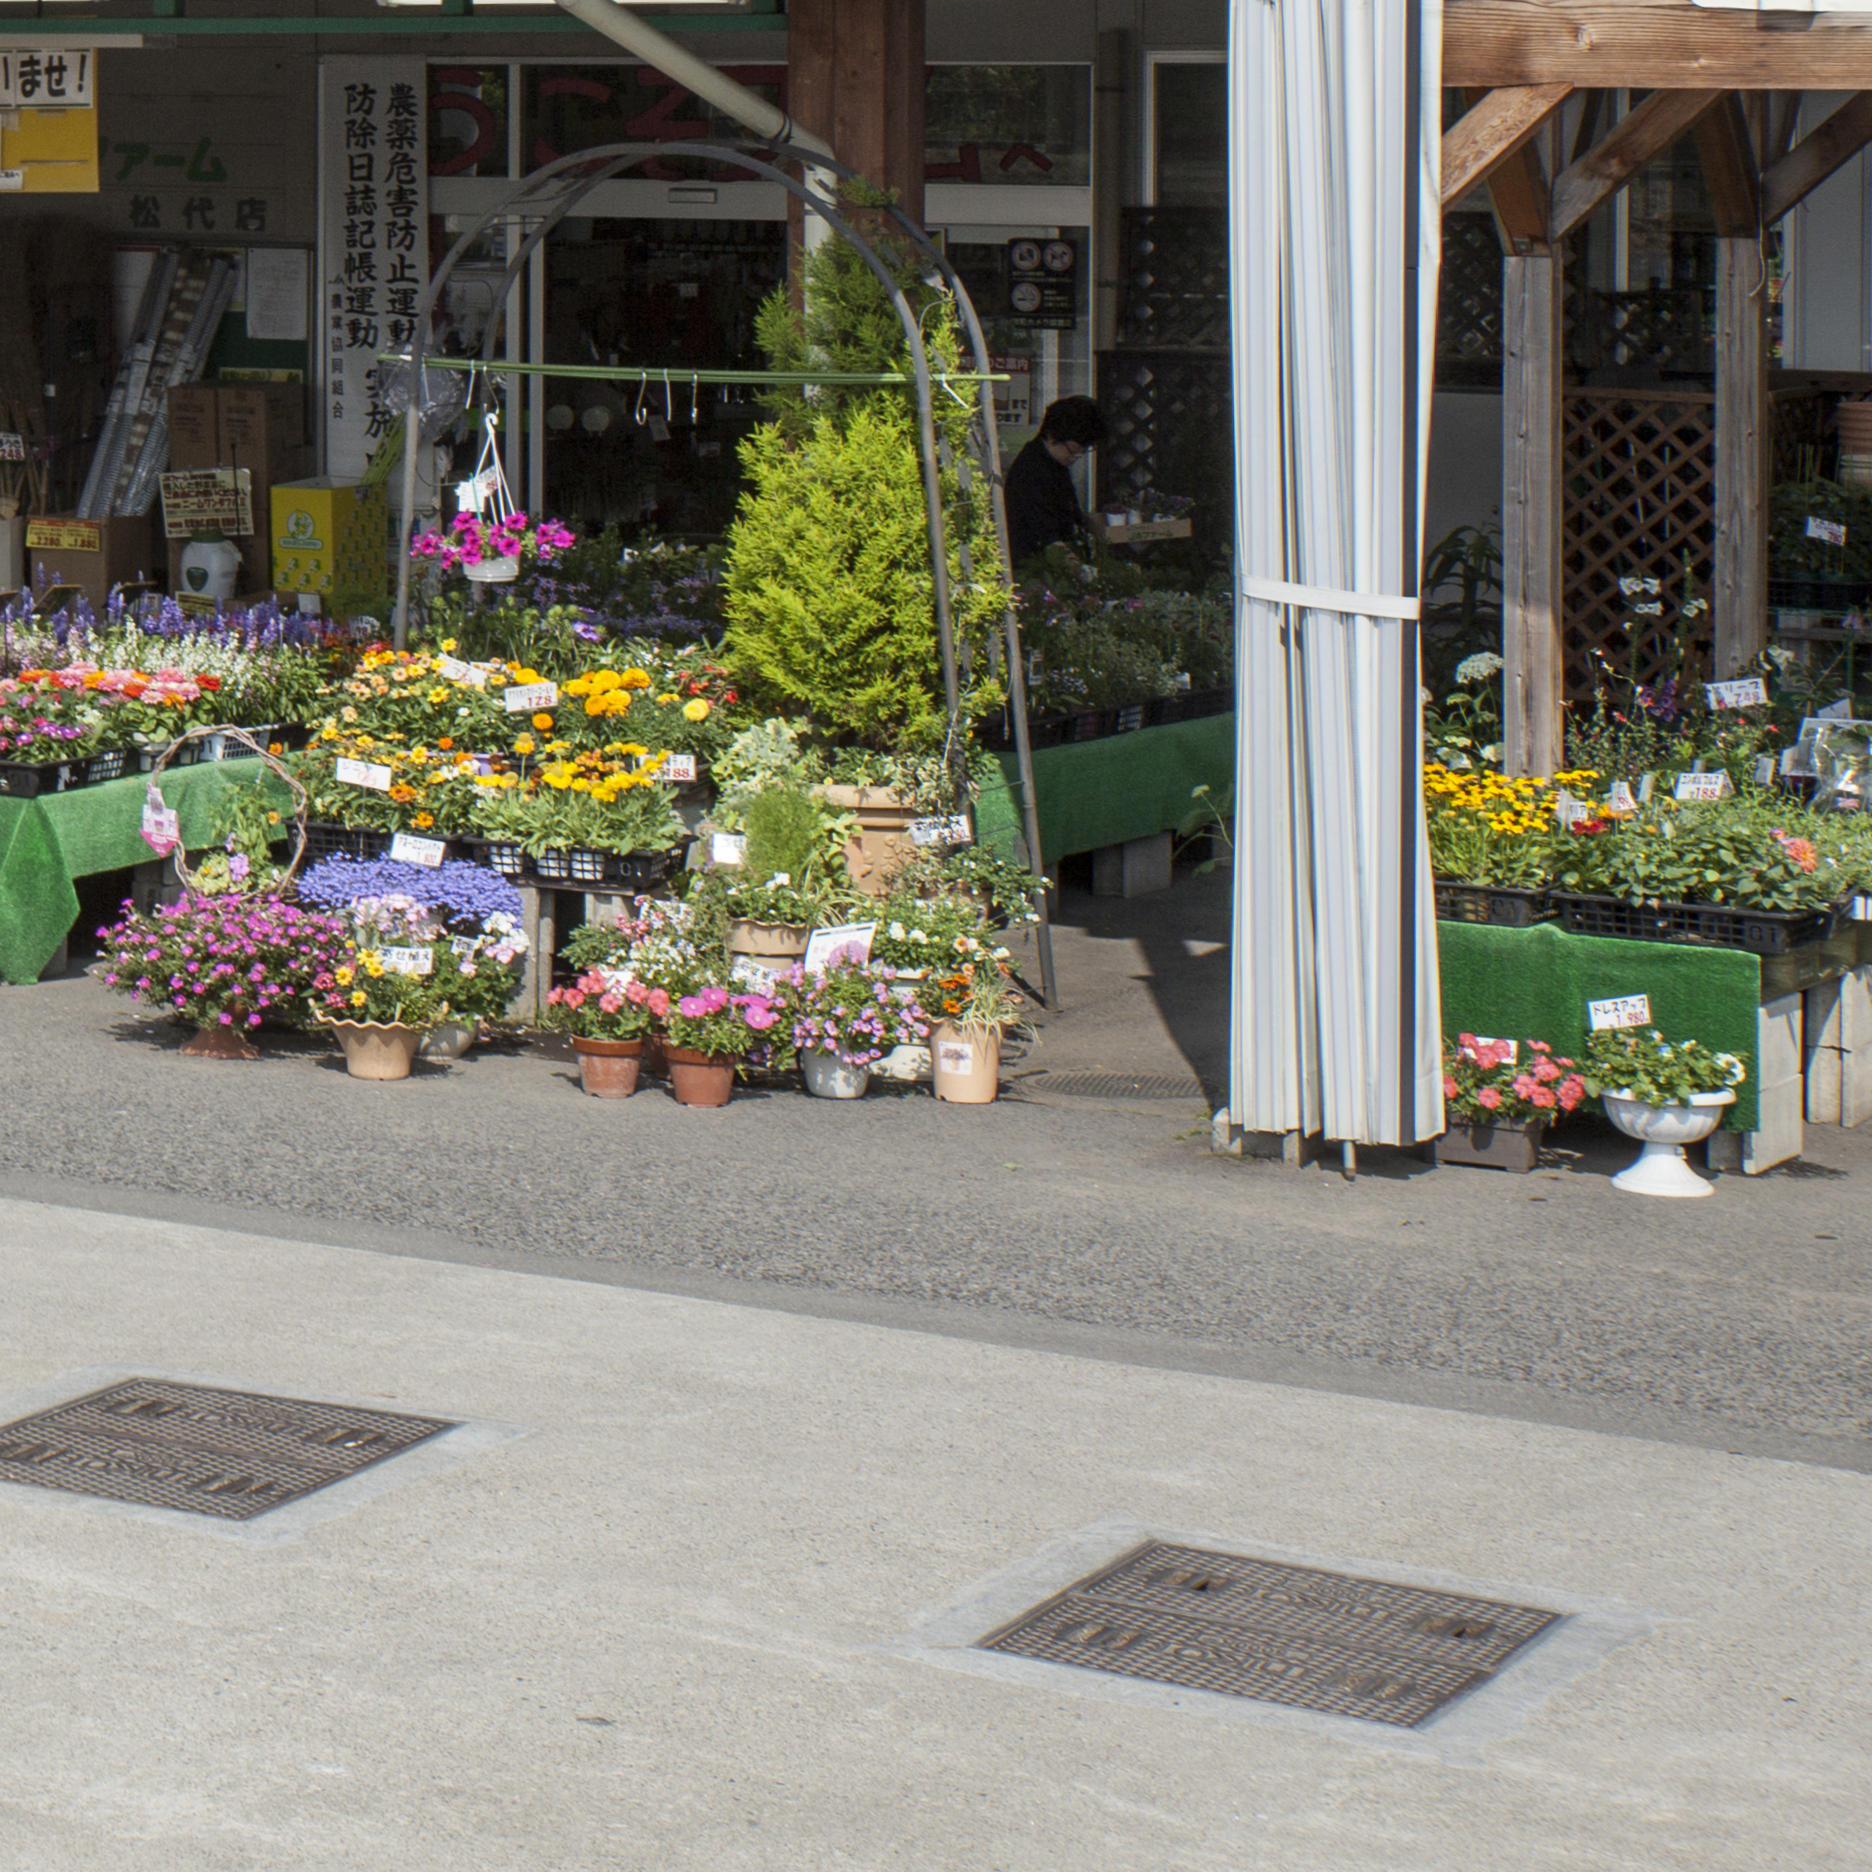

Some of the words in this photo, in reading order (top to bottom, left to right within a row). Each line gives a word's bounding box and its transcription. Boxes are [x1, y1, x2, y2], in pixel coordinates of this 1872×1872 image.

[129, 194, 267, 231] 松代店
[343, 81, 380, 350] 防除日誌記帳運動
[384, 81, 421, 346] 農薬危害防止運動
[526, 694, 553, 707] 128
